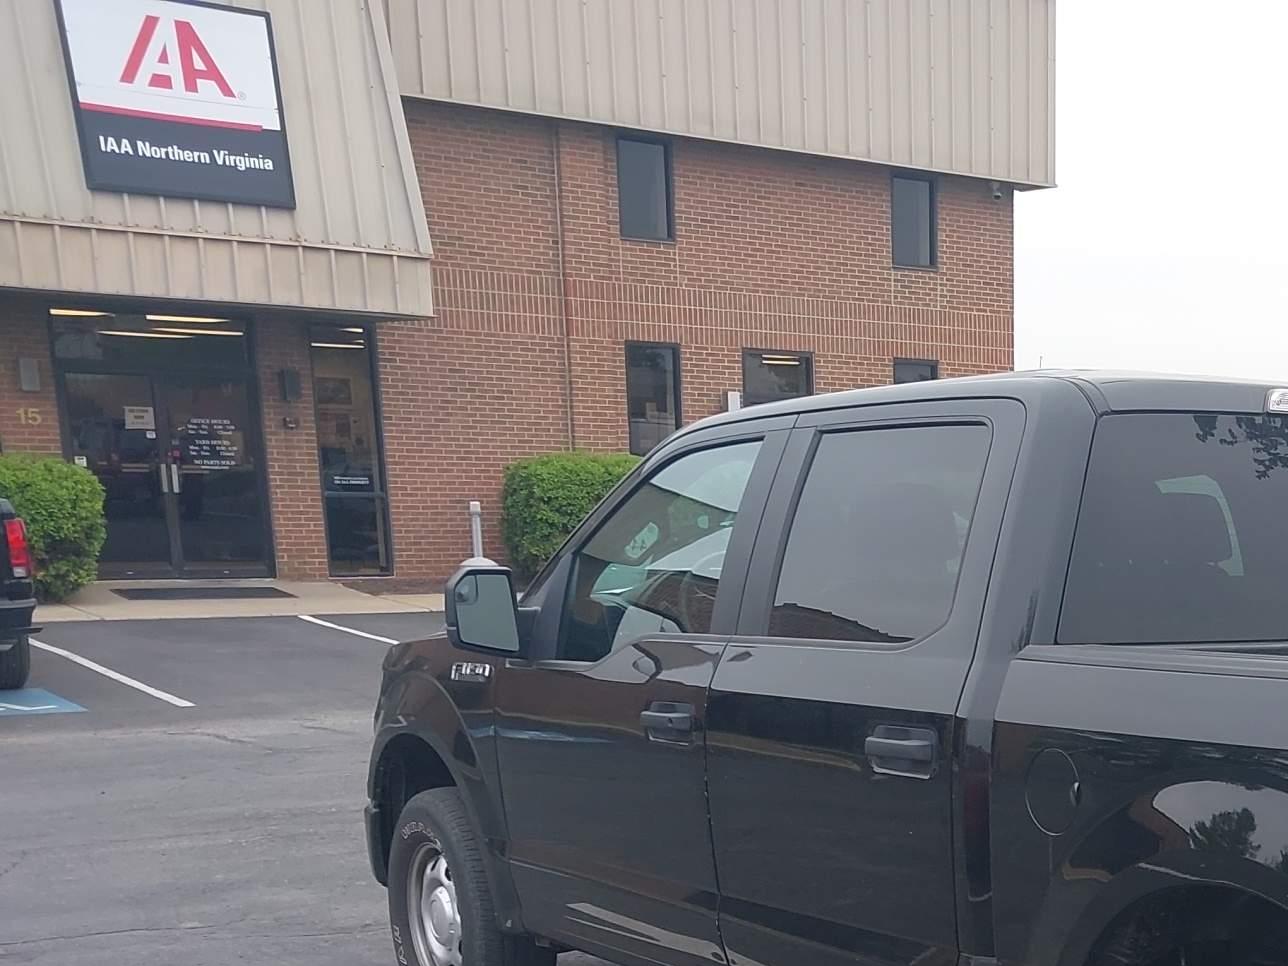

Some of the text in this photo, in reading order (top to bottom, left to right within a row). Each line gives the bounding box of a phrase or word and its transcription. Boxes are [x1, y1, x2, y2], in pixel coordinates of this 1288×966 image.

[119, 15, 237, 98] IAA
[99, 135, 274, 171] IAA Northern Virginia
[16, 408, 42, 425] 15
